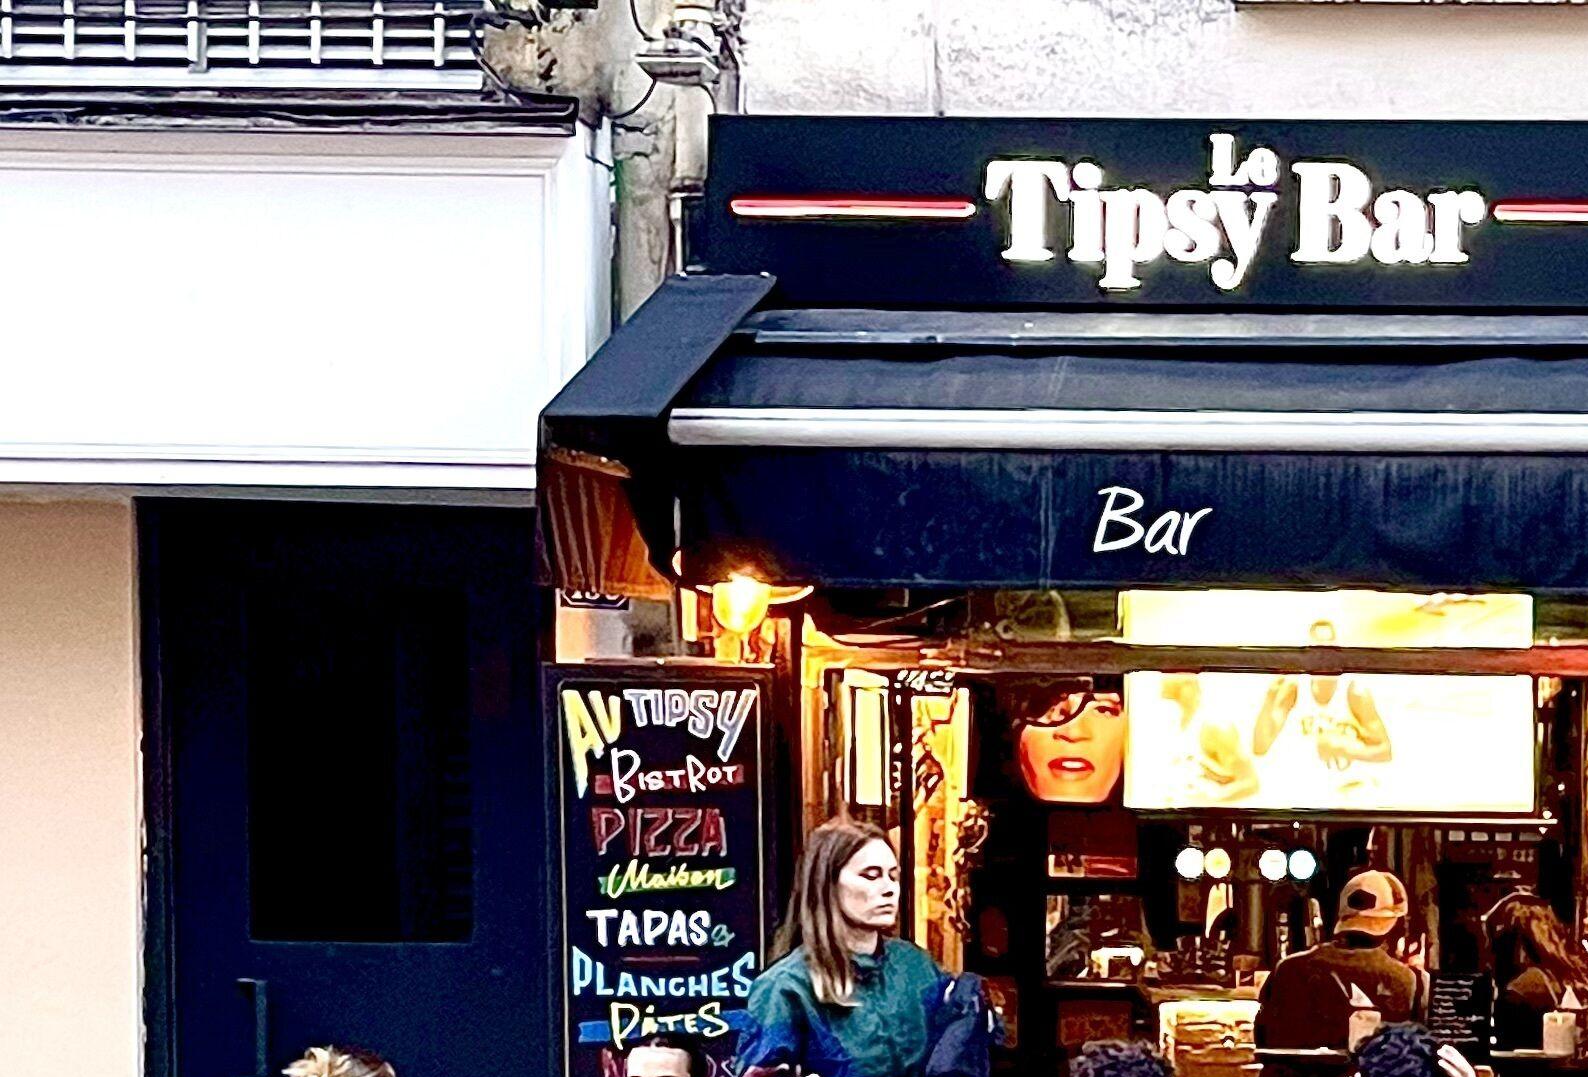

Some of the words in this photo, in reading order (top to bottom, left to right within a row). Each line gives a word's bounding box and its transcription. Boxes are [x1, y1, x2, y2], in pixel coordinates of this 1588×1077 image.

[1209, 133, 1277, 187] Le
[984, 160, 1278, 290] Tipsy
[1290, 161, 1485, 264] Bar
[1092, 486, 1213, 556] Bar
[622, 688, 758, 762] TIPSY
[590, 807, 728, 857] PIZZA
[585, 908, 712, 947] TAPAS
[572, 945, 756, 998] PLANCHES
